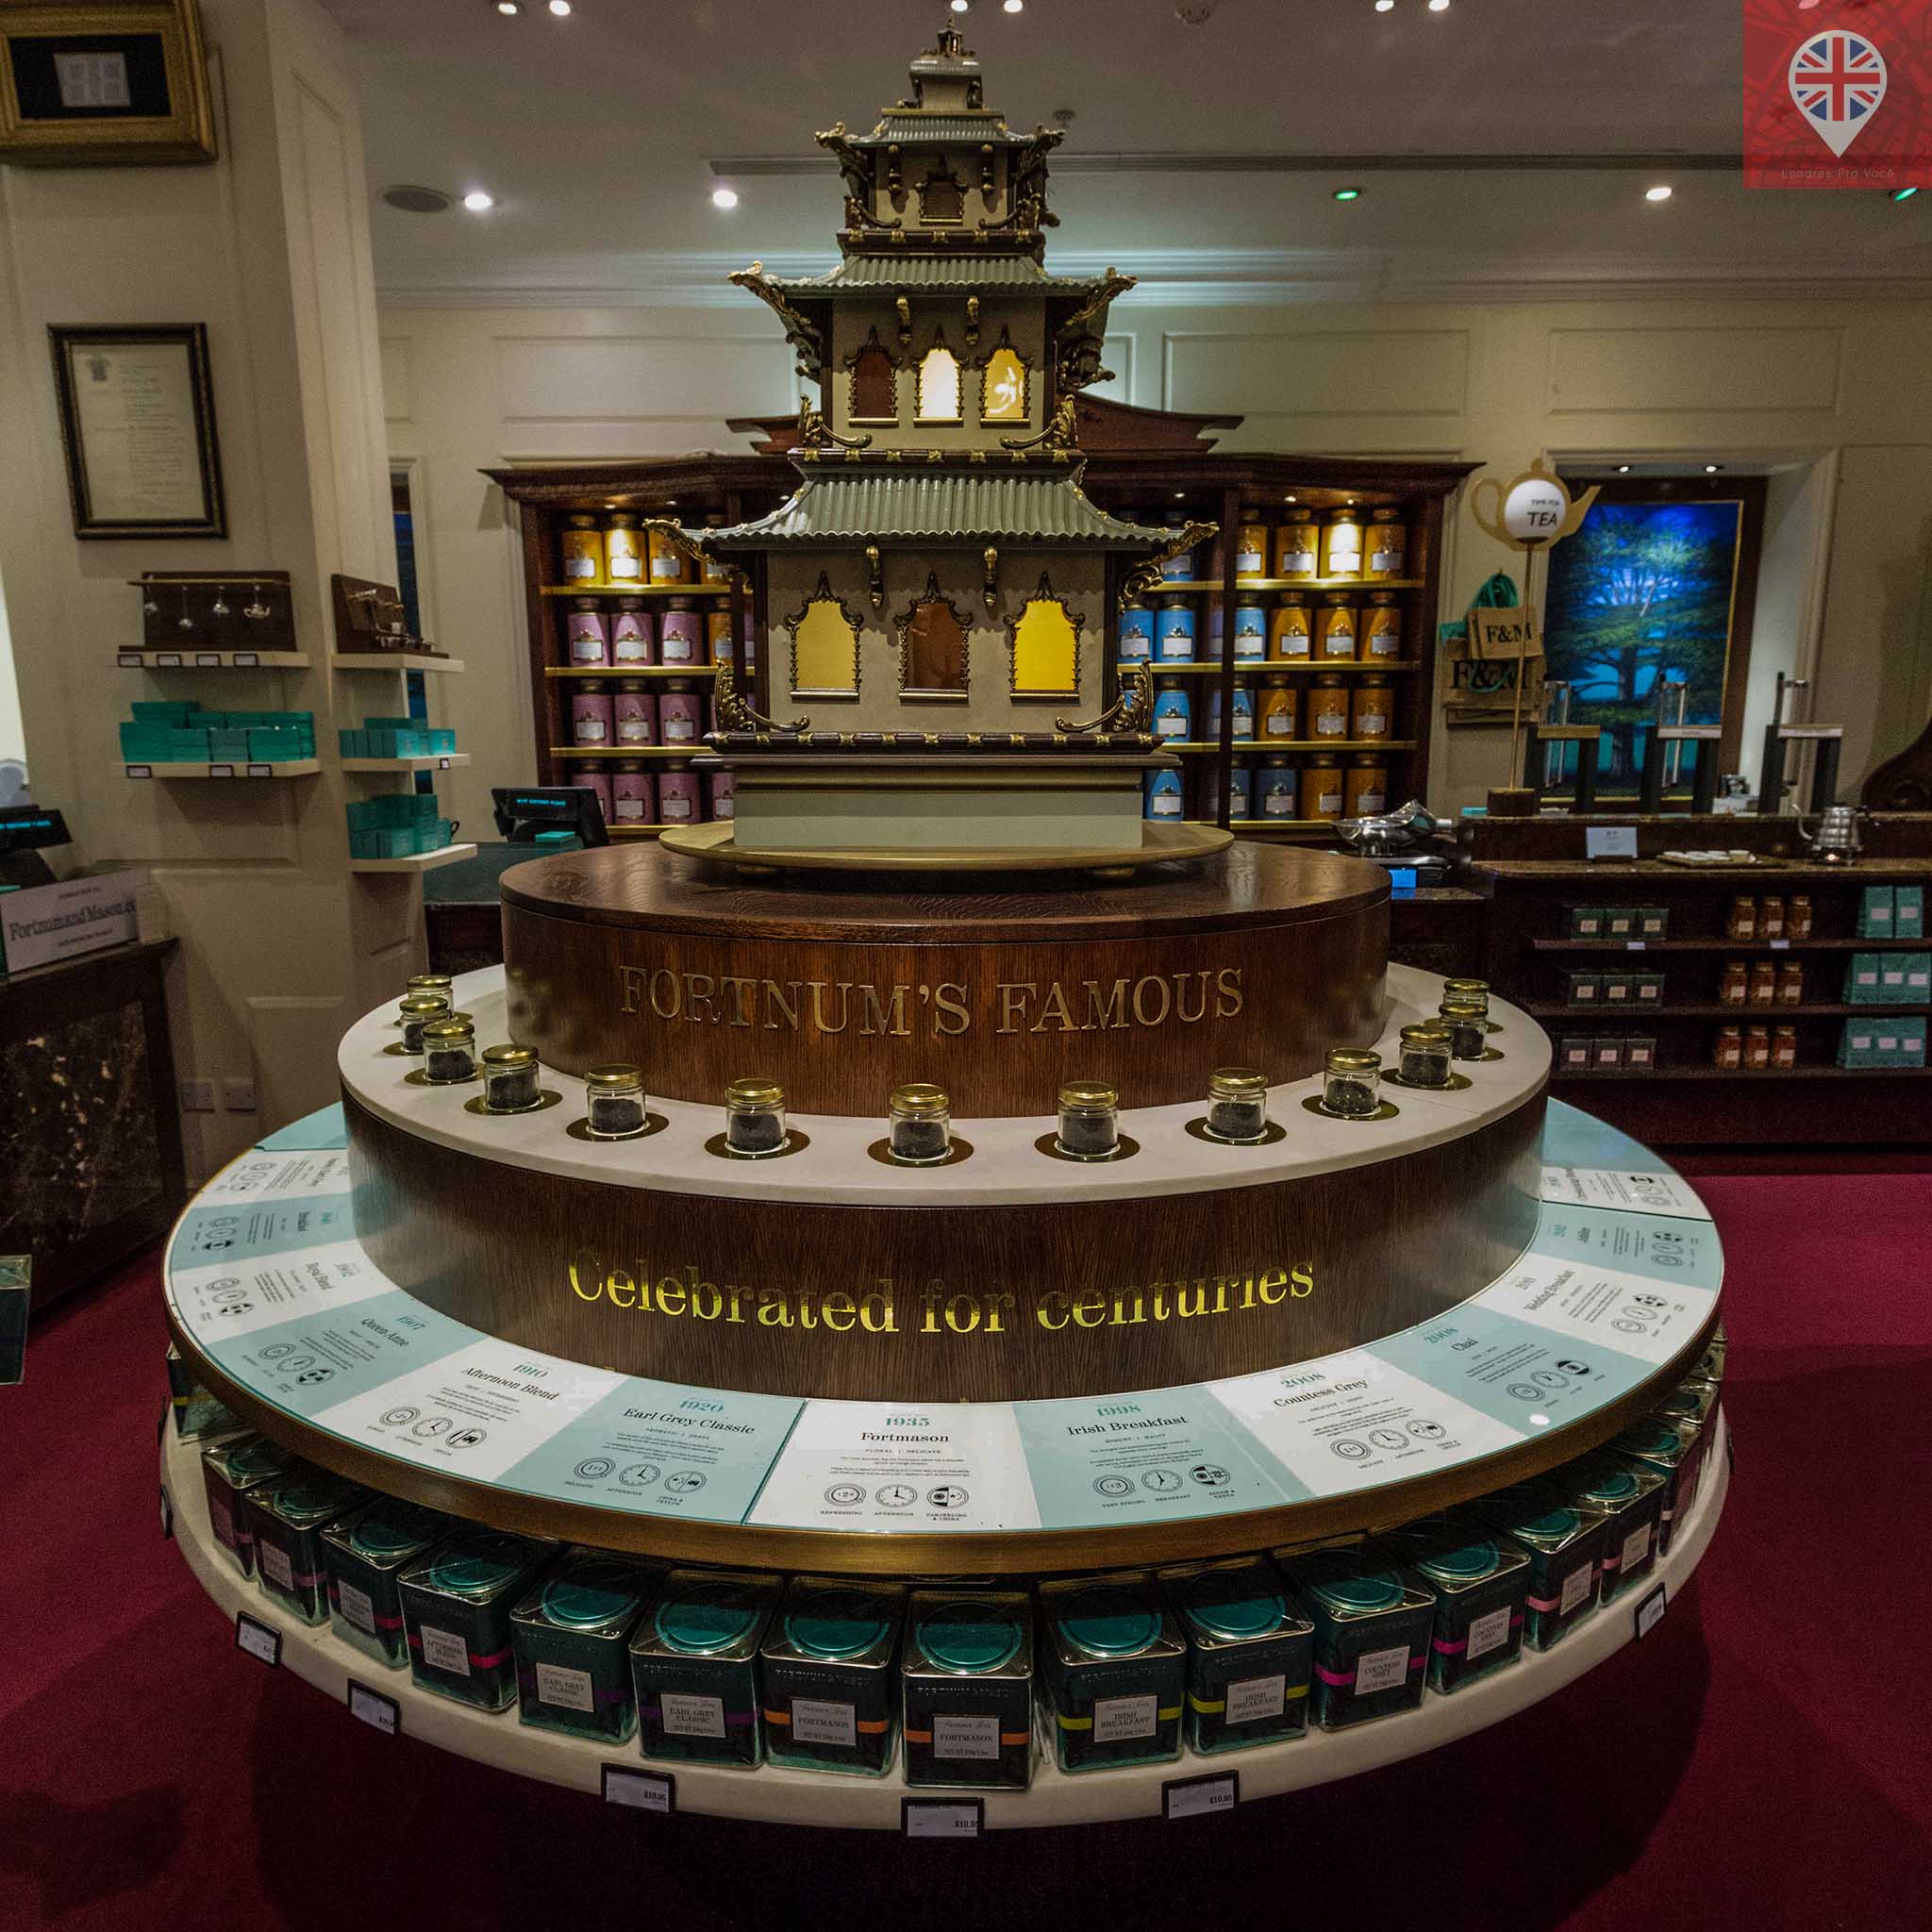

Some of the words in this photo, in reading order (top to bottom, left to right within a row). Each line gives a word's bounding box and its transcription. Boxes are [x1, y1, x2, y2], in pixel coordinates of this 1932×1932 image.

[1527, 511, 1557, 526] TEA
[1487, 623, 1532, 643] F&M
[995, 968, 1243, 1034] FAMOUS
[568, 1250, 899, 1333] Celebrated
[920, 1277, 1015, 1333] for
[1037, 1257, 1313, 1330] centuries
[1451, 1337, 1479, 1351] Chai
[513, 1364, 549, 1379] 1910
[459, 1367, 522, 1391] Afternoon
[521, 1383, 560, 1402] Blend
[1280, 1373, 1325, 1389] 2008
[1274, 1389, 1336, 1408] Countess
[1334, 1378, 1369, 1393] Grey
[679, 1400, 724, 1413] 1920
[1096, 1404, 1141, 1418] 1998
[623, 1407, 658, 1421] Earl
[659, 1414, 699, 1428] Grey
[699, 1419, 755, 1435] Classic
[885, 1417, 931, 1426] 1935
[1067, 1423, 1107, 1437] Irish
[1108, 1415, 1189, 1432] Breakfast
[860, 1432, 950, 1443] Fortmason
[670, 1707, 691, 1716] EARL
[798, 1717, 850, 1728] FORTMASON
[1101, 1717, 1149, 1728] BREAKFAST
[940, 1735, 994, 1743] FORTMASON
